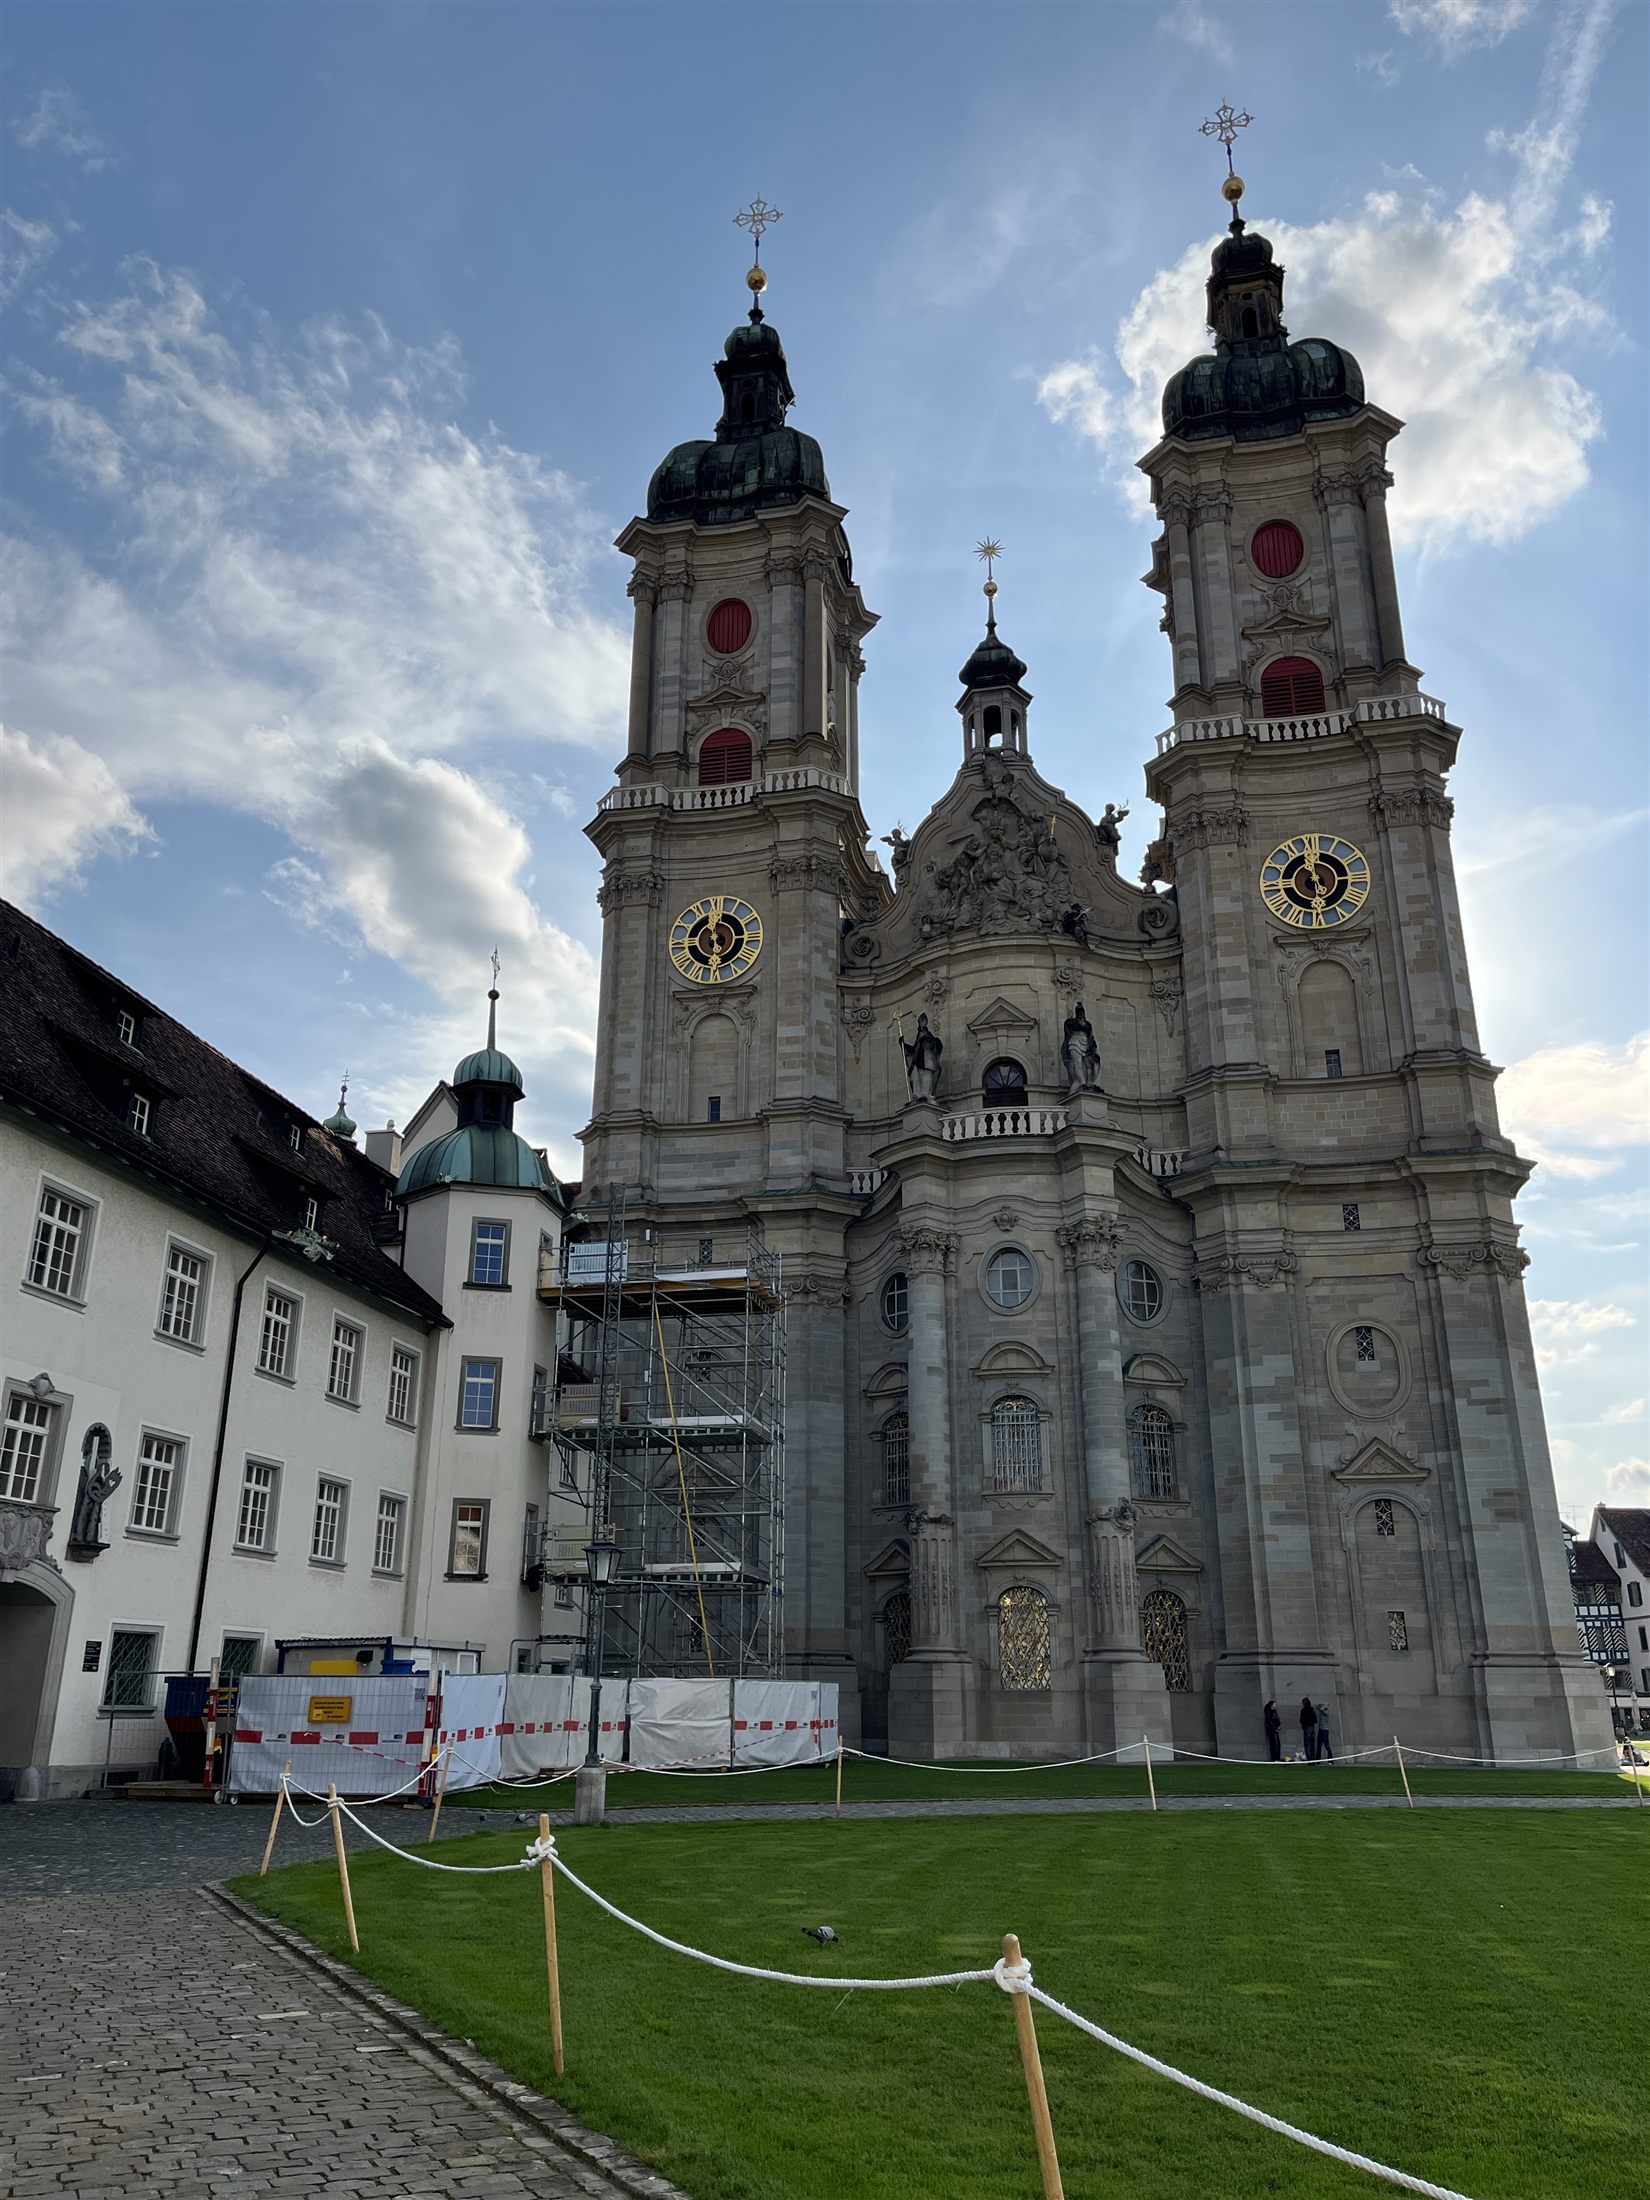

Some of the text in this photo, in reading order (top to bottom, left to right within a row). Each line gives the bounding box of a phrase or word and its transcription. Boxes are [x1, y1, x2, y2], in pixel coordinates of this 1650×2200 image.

[1303, 835, 1319, 851] XII
[1343, 851, 1360, 865] II
[1350, 872, 1368, 882] III
[710, 897, 724, 911] XII
[742, 912, 757, 924] II
[746, 931, 761, 941] III
